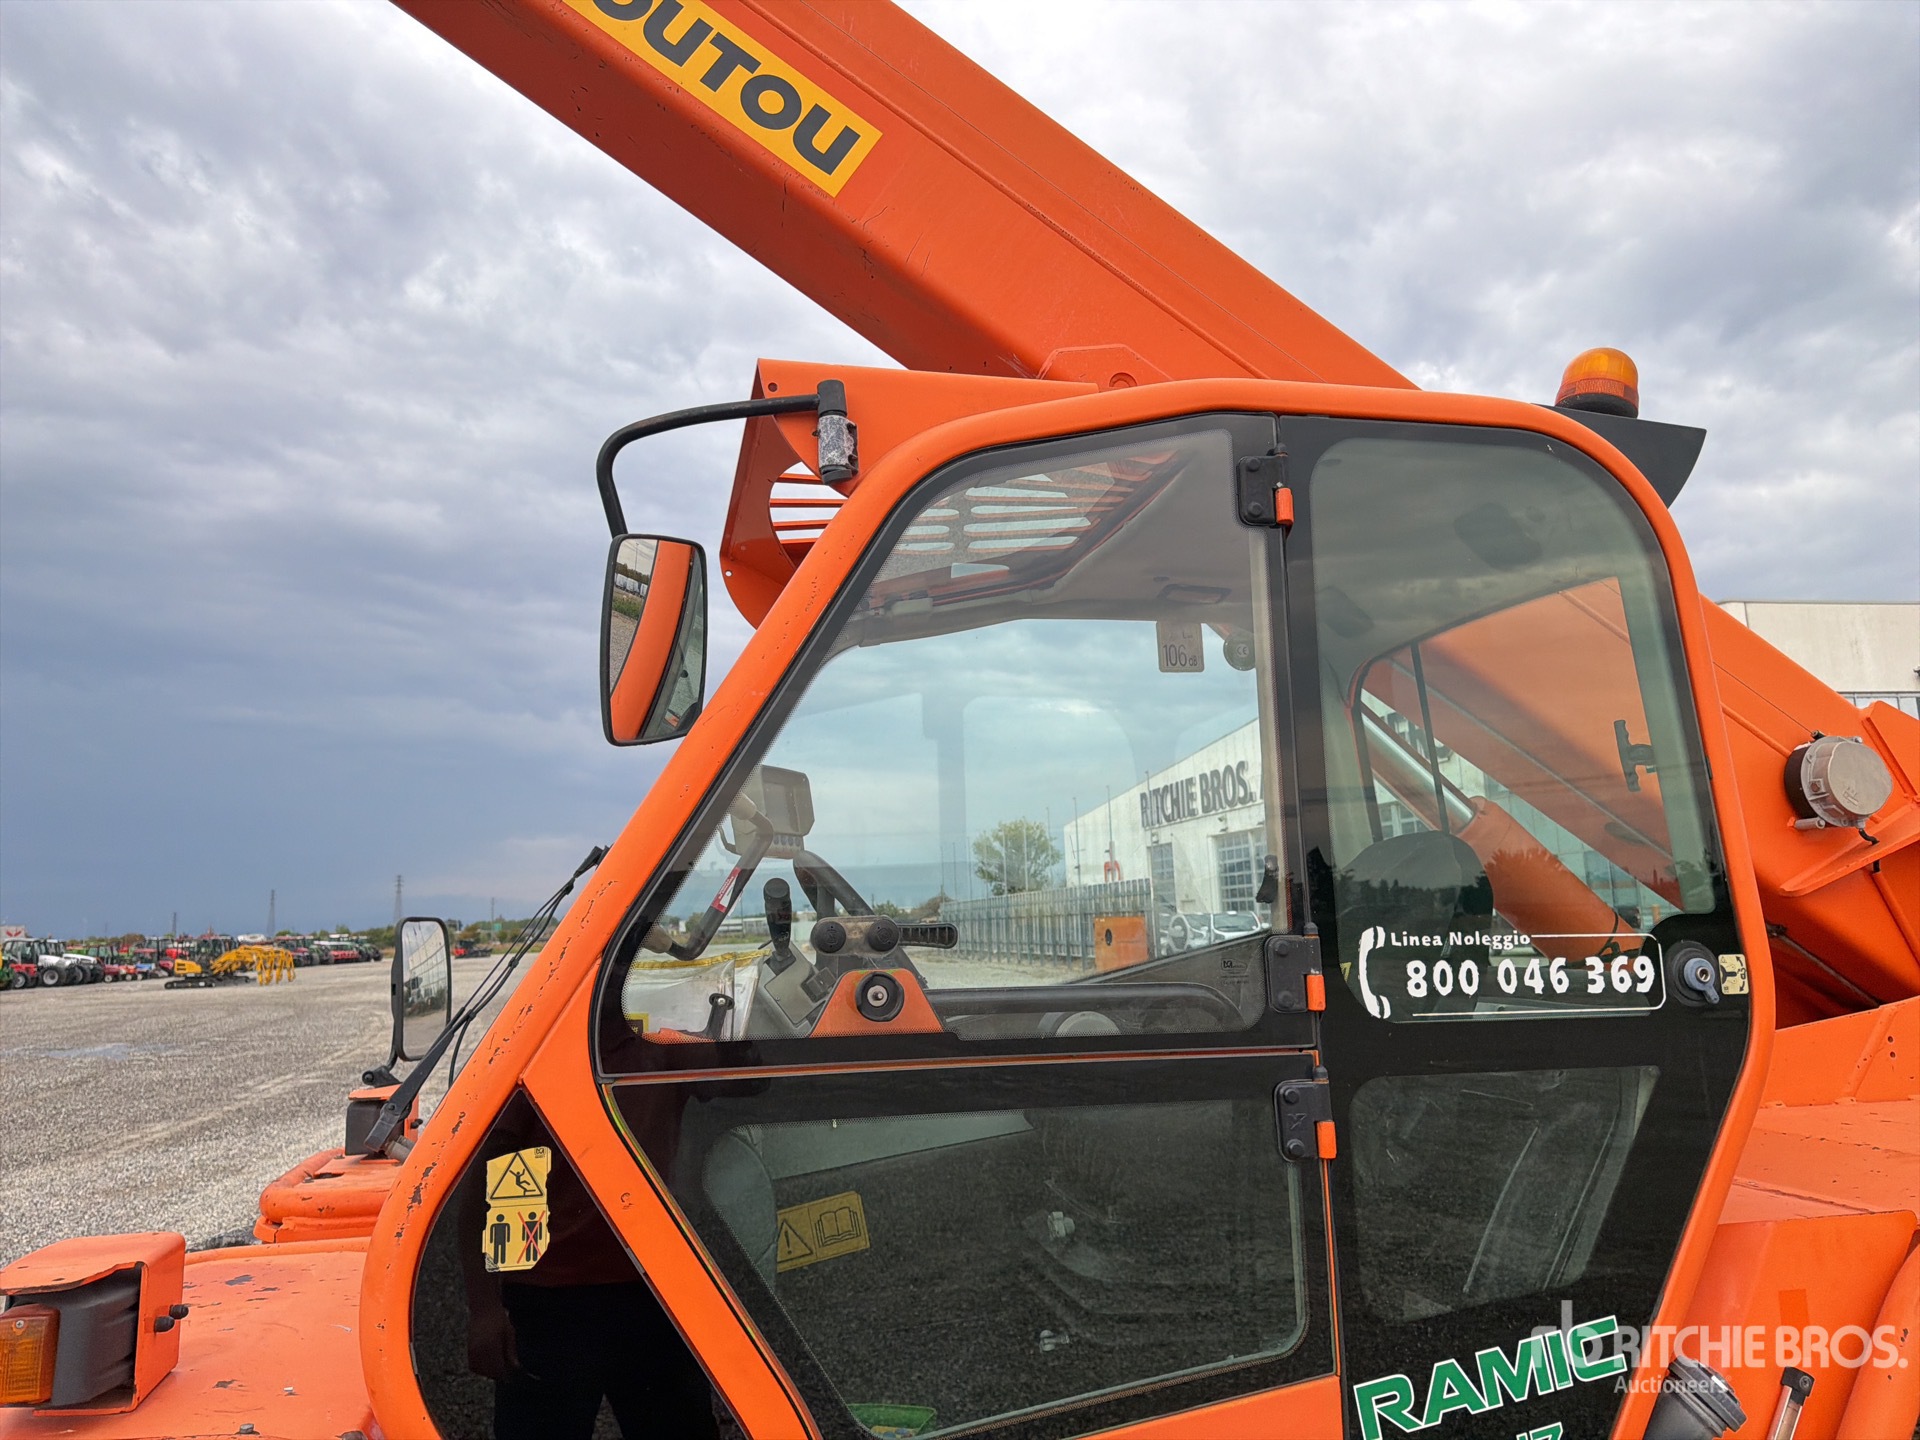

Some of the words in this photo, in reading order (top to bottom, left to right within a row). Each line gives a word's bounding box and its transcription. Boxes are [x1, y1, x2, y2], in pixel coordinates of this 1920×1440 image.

[1163, 644, 1187, 667] 106
[1140, 776, 1198, 828] RITCHIE
[1199, 760, 1257, 814] BROS.
[1391, 931, 1443, 946] Linea
[1449, 930, 1530, 950] Noleggio
[1406, 959, 1479, 998] 800
[1497, 957, 1569, 994] 046
[1585, 955, 1655, 994] 369
[1353, 1315, 1627, 1440] RAMIC
